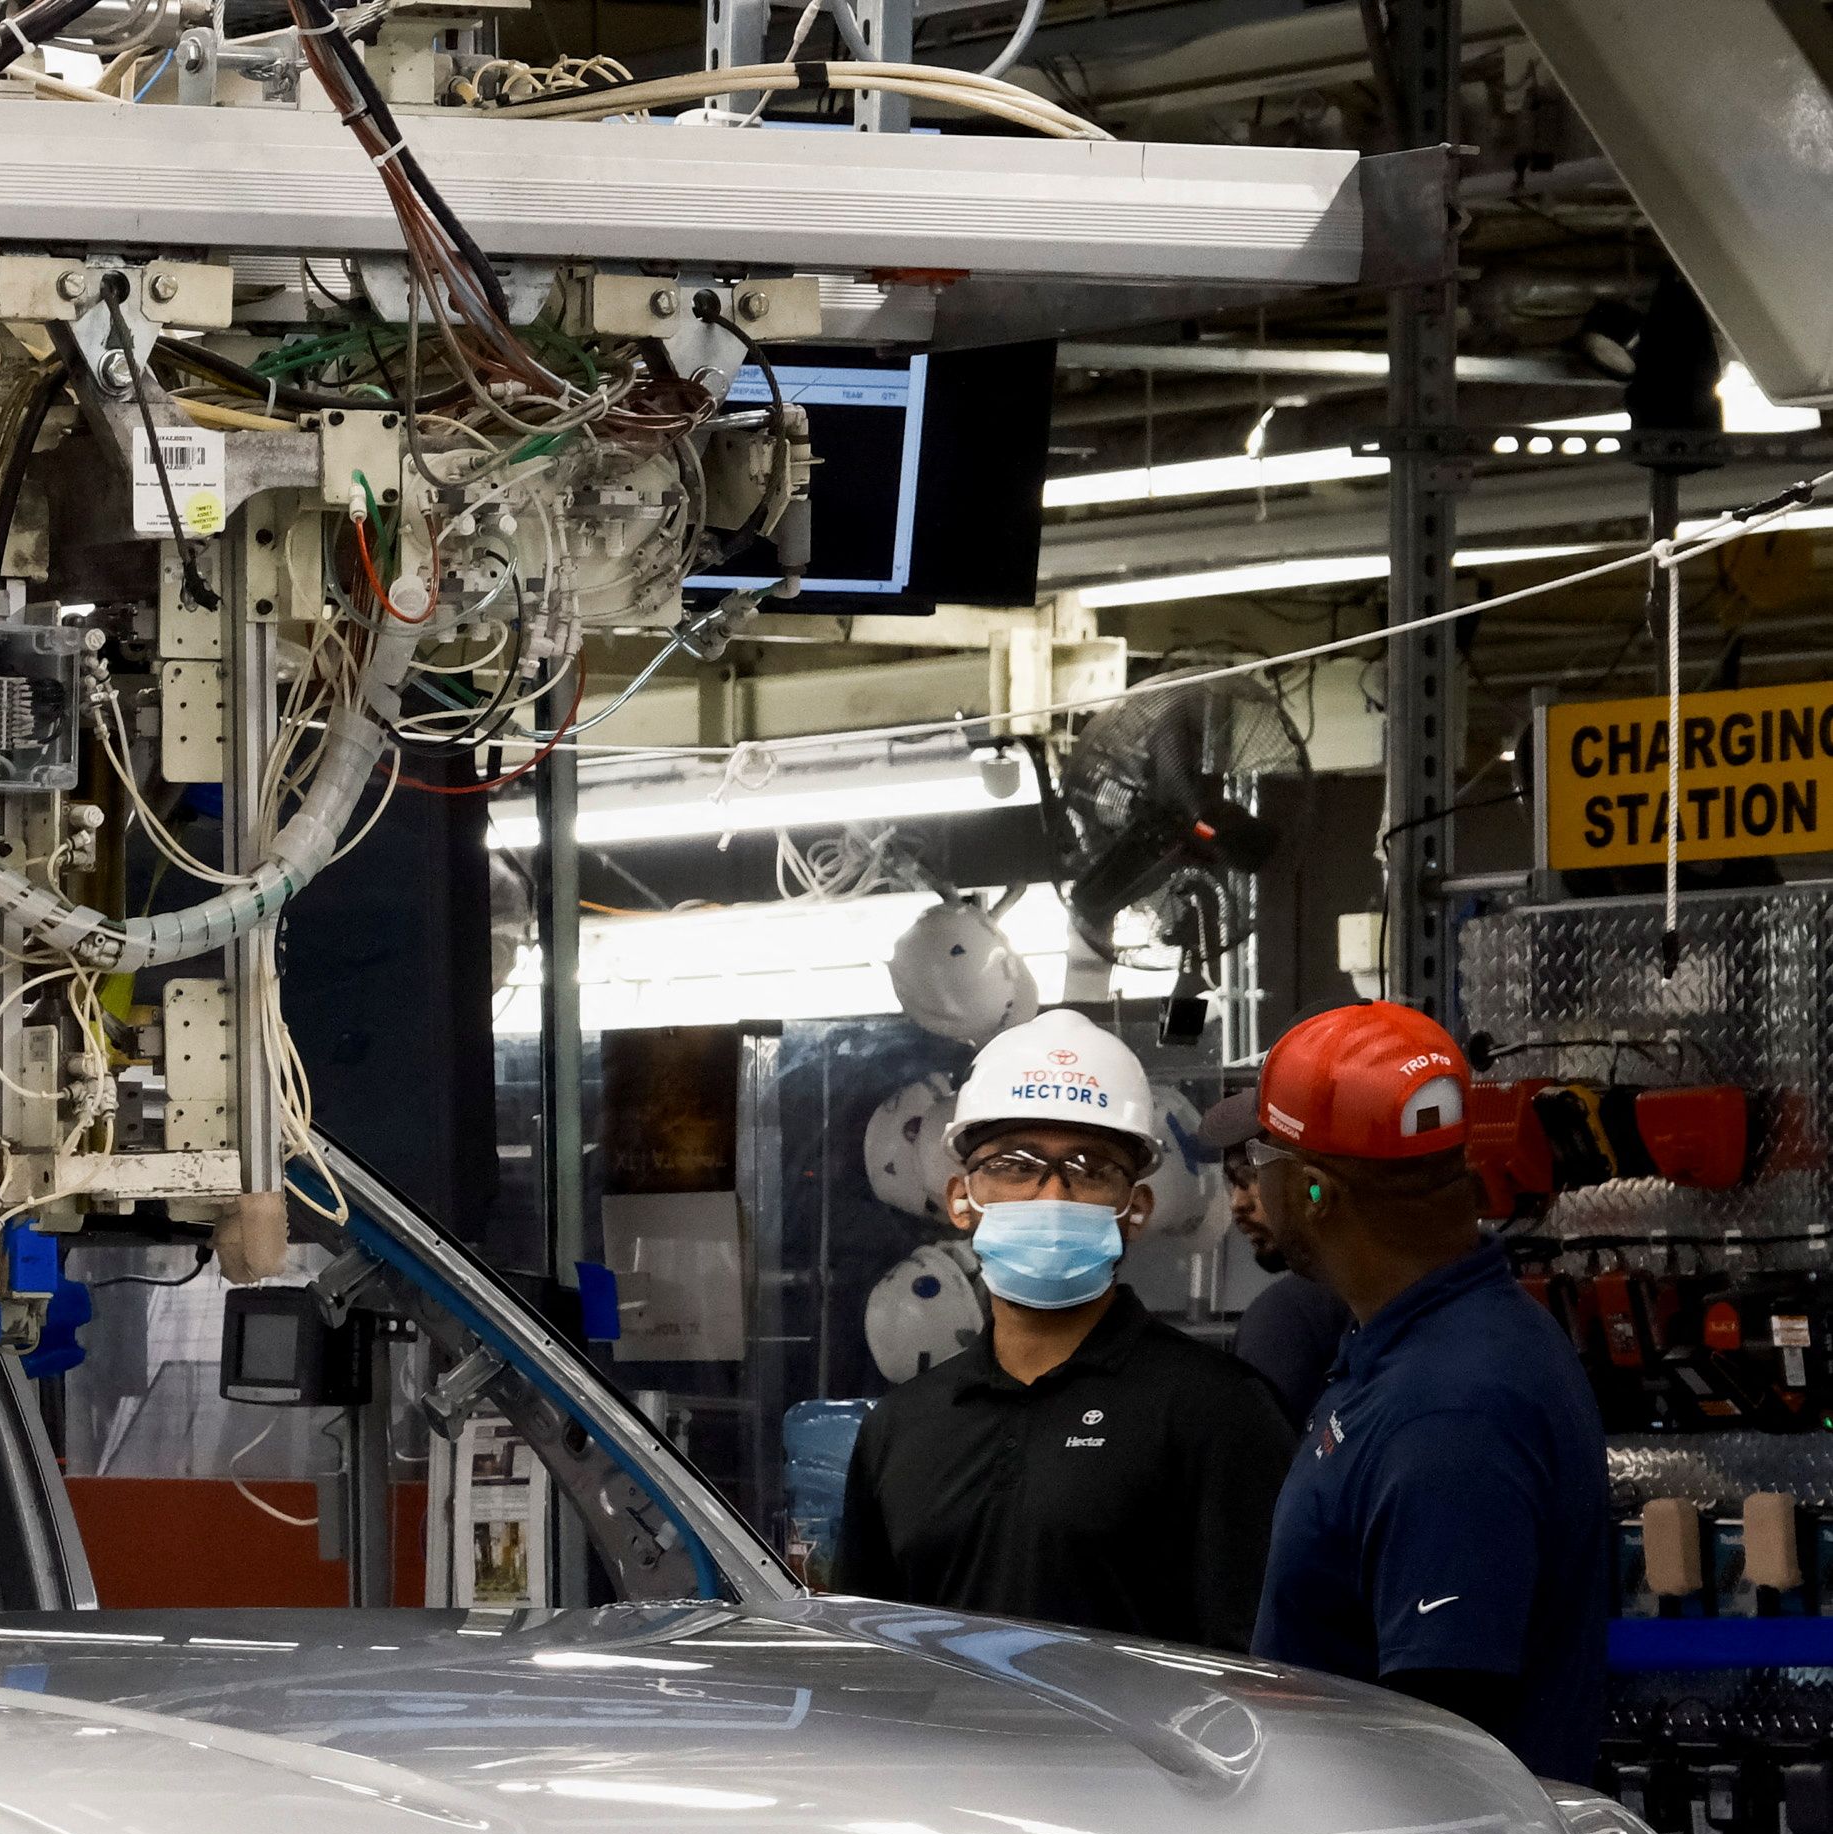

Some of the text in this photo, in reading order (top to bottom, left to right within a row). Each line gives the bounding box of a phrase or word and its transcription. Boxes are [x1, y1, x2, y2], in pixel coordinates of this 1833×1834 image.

[1585, 779, 1817, 848] STATION
[1399, 1052, 1451, 1076] TRD Pro
[1023, 1070, 1099, 1088] TOYOTA
[1065, 1436, 1106, 1447] Hector
